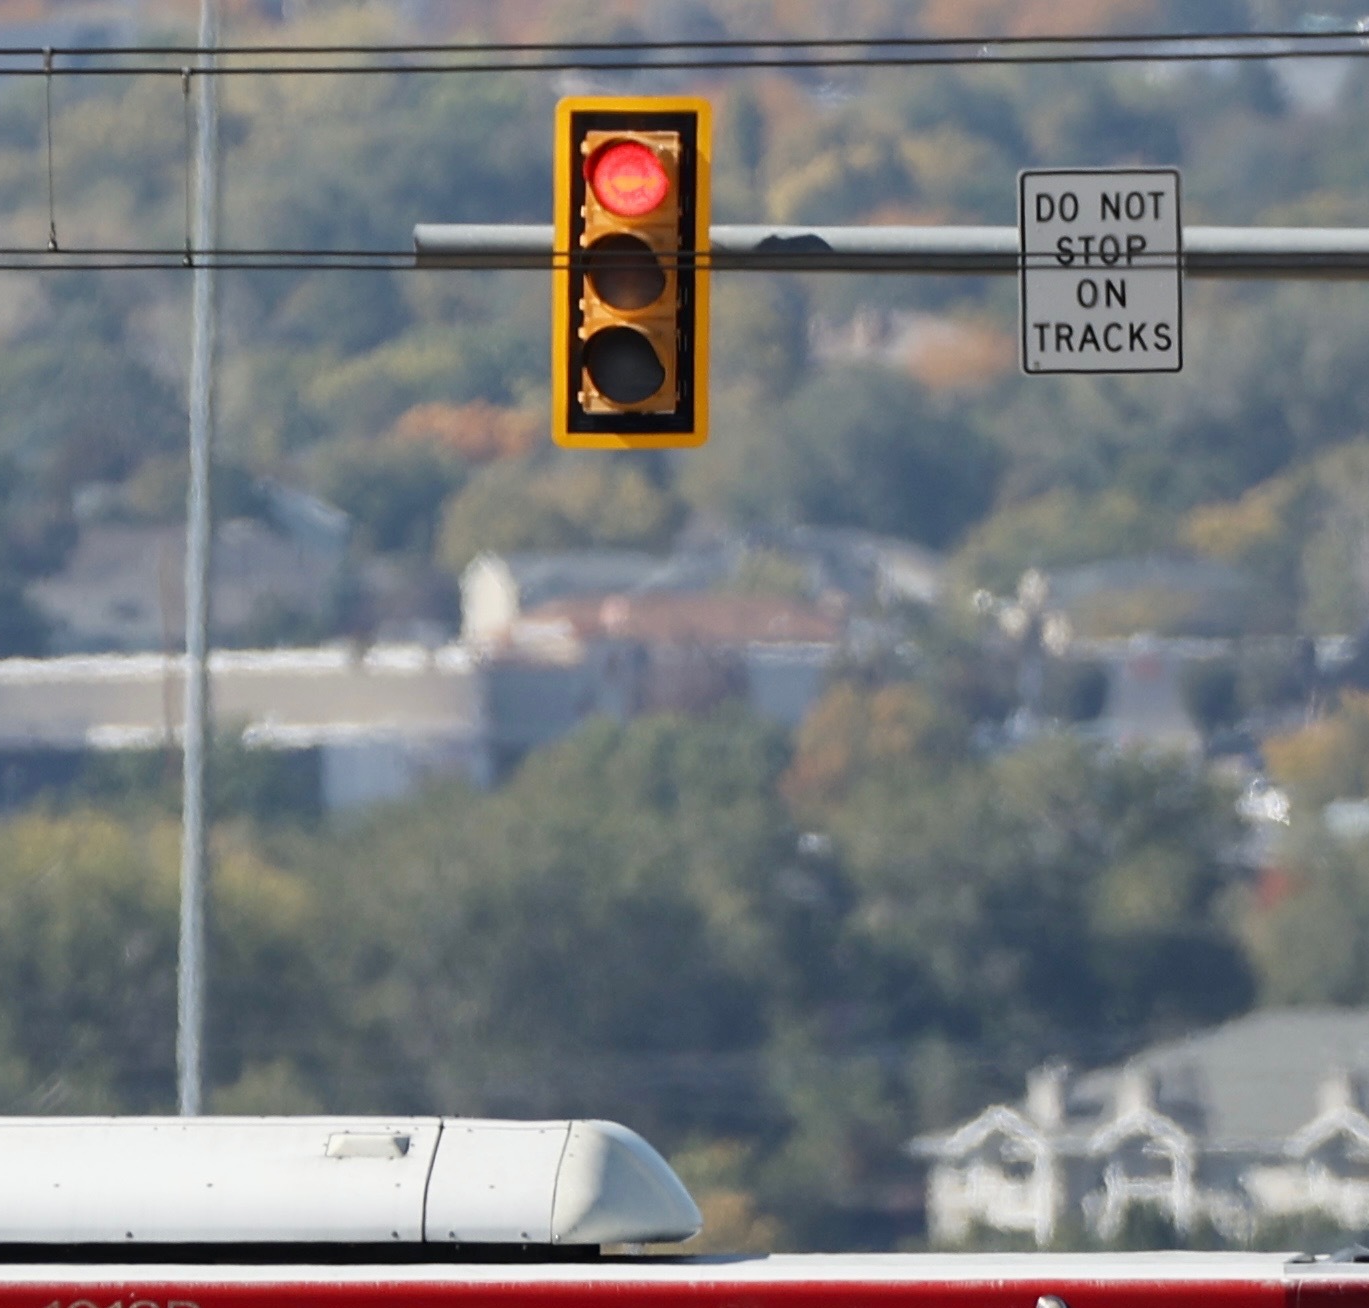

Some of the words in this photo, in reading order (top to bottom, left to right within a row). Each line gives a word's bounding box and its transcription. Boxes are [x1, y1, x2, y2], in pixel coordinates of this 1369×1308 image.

[1036, 192, 1079, 223] DO
[1100, 191, 1165, 221] NOT
[1056, 234, 1147, 265] STOP
[1077, 278, 1126, 309] ON
[1033, 322, 1172, 352] TRACKS
